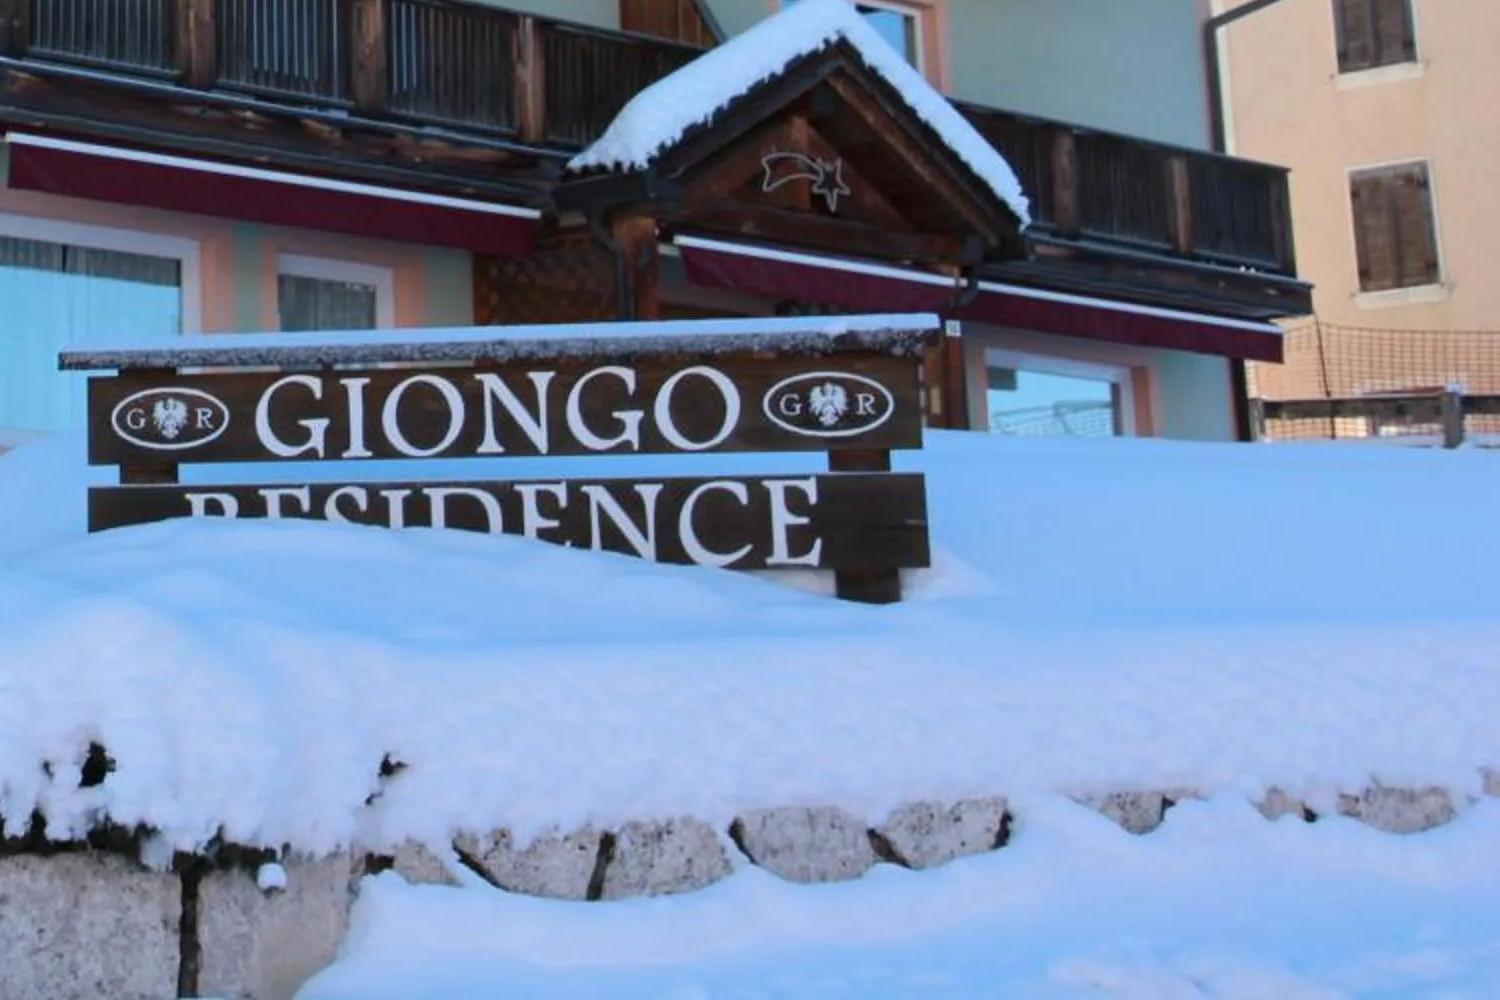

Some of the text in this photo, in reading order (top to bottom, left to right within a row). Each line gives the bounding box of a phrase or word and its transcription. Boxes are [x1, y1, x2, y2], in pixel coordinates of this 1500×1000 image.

[255, 365, 741, 459] GIONGO
[779, 393, 876, 416] G R
[126, 407, 215, 429] G R
